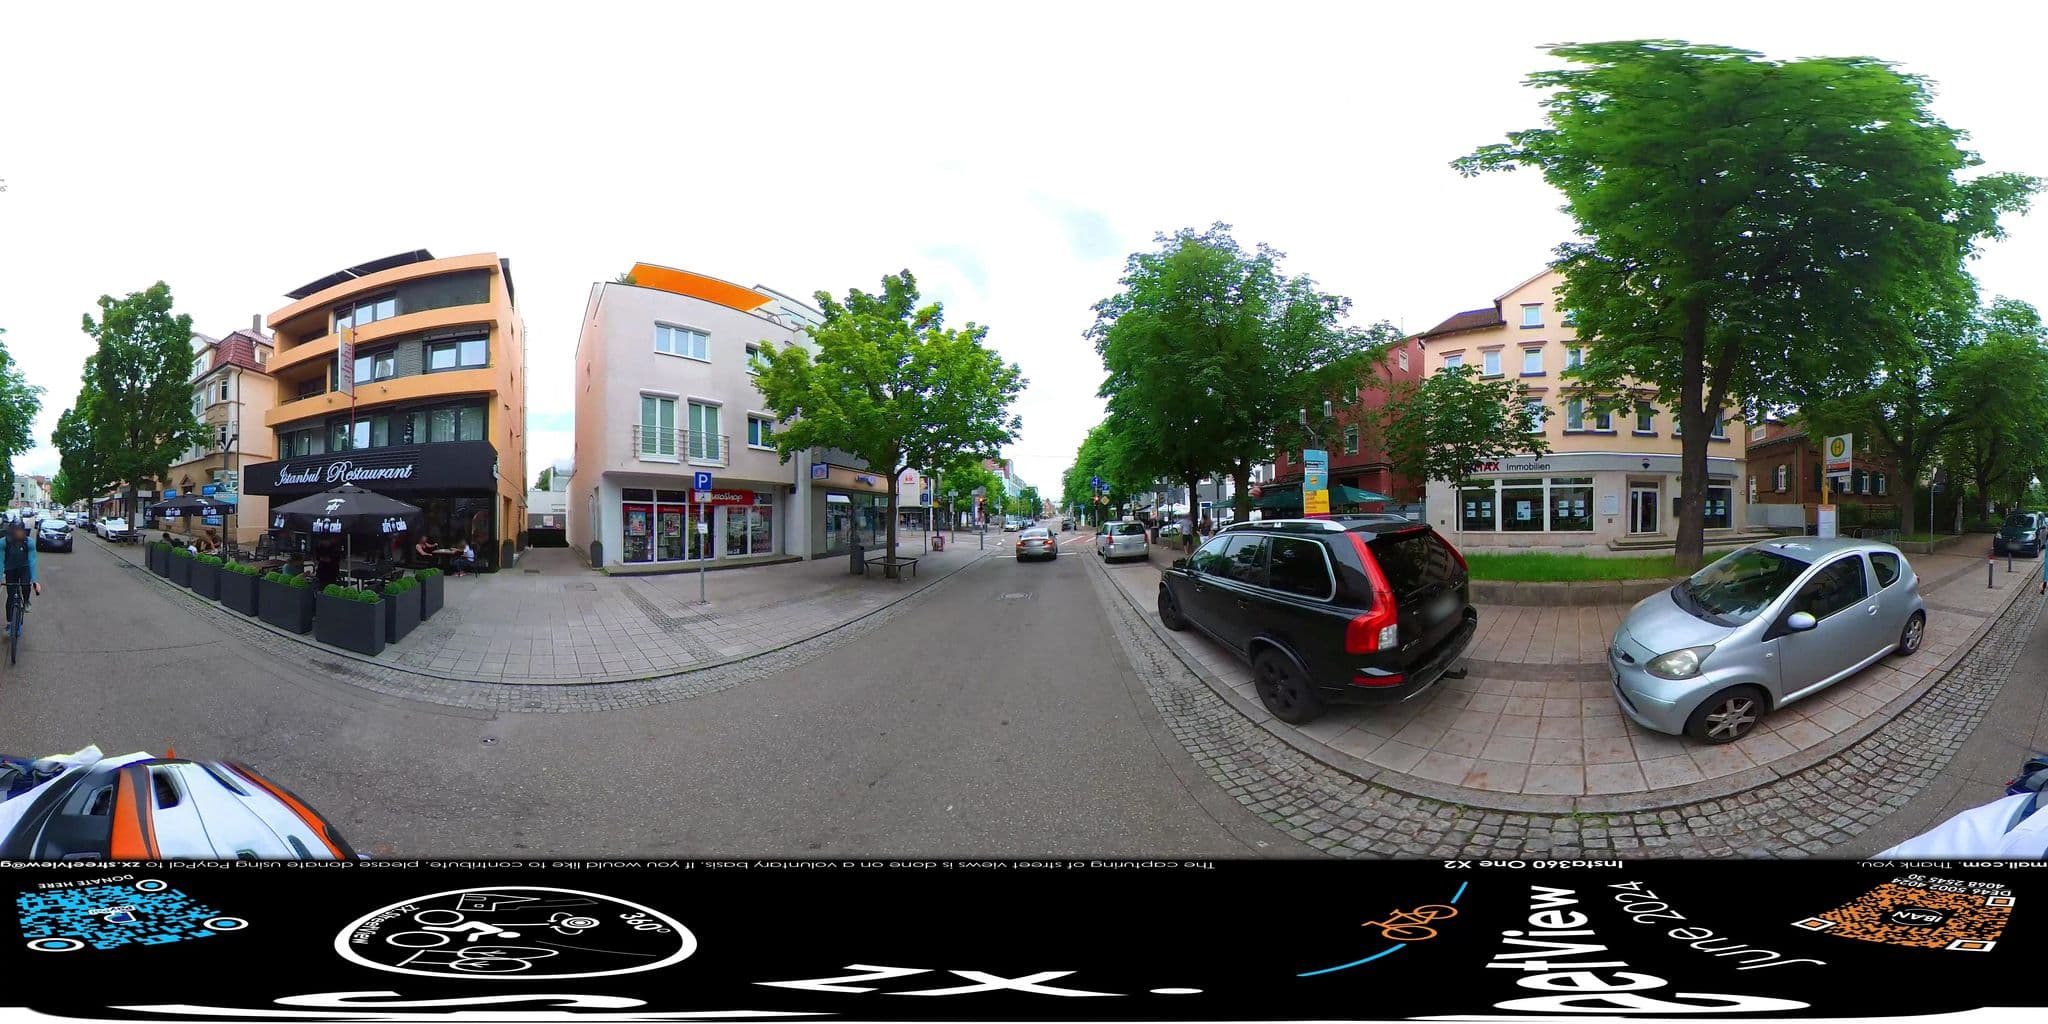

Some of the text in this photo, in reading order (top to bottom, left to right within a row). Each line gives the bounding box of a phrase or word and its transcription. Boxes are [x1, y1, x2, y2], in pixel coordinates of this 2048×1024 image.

[274, 460, 413, 486] Istanbul Restaurant
[1506, 463, 1551, 471] Immobilien
[698, 474, 708, 489] P
